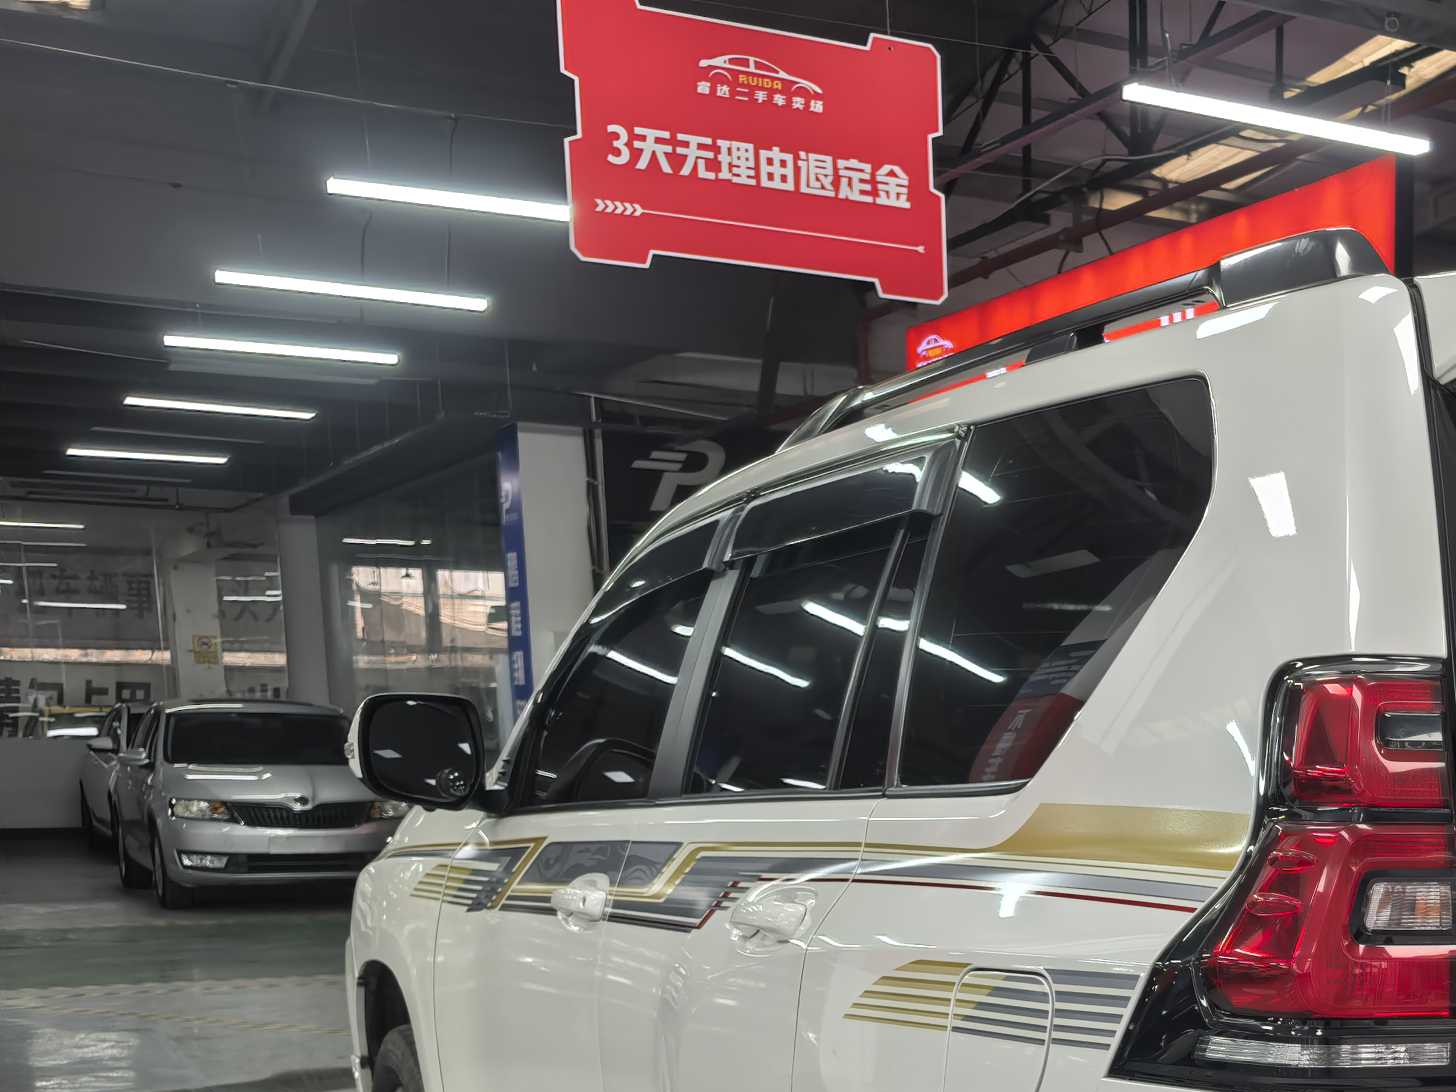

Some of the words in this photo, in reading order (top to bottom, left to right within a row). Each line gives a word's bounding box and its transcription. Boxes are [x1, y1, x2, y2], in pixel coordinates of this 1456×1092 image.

[738, 74, 783, 90] RUIDA
[606, 124, 912, 208] 3天无理由退定金
